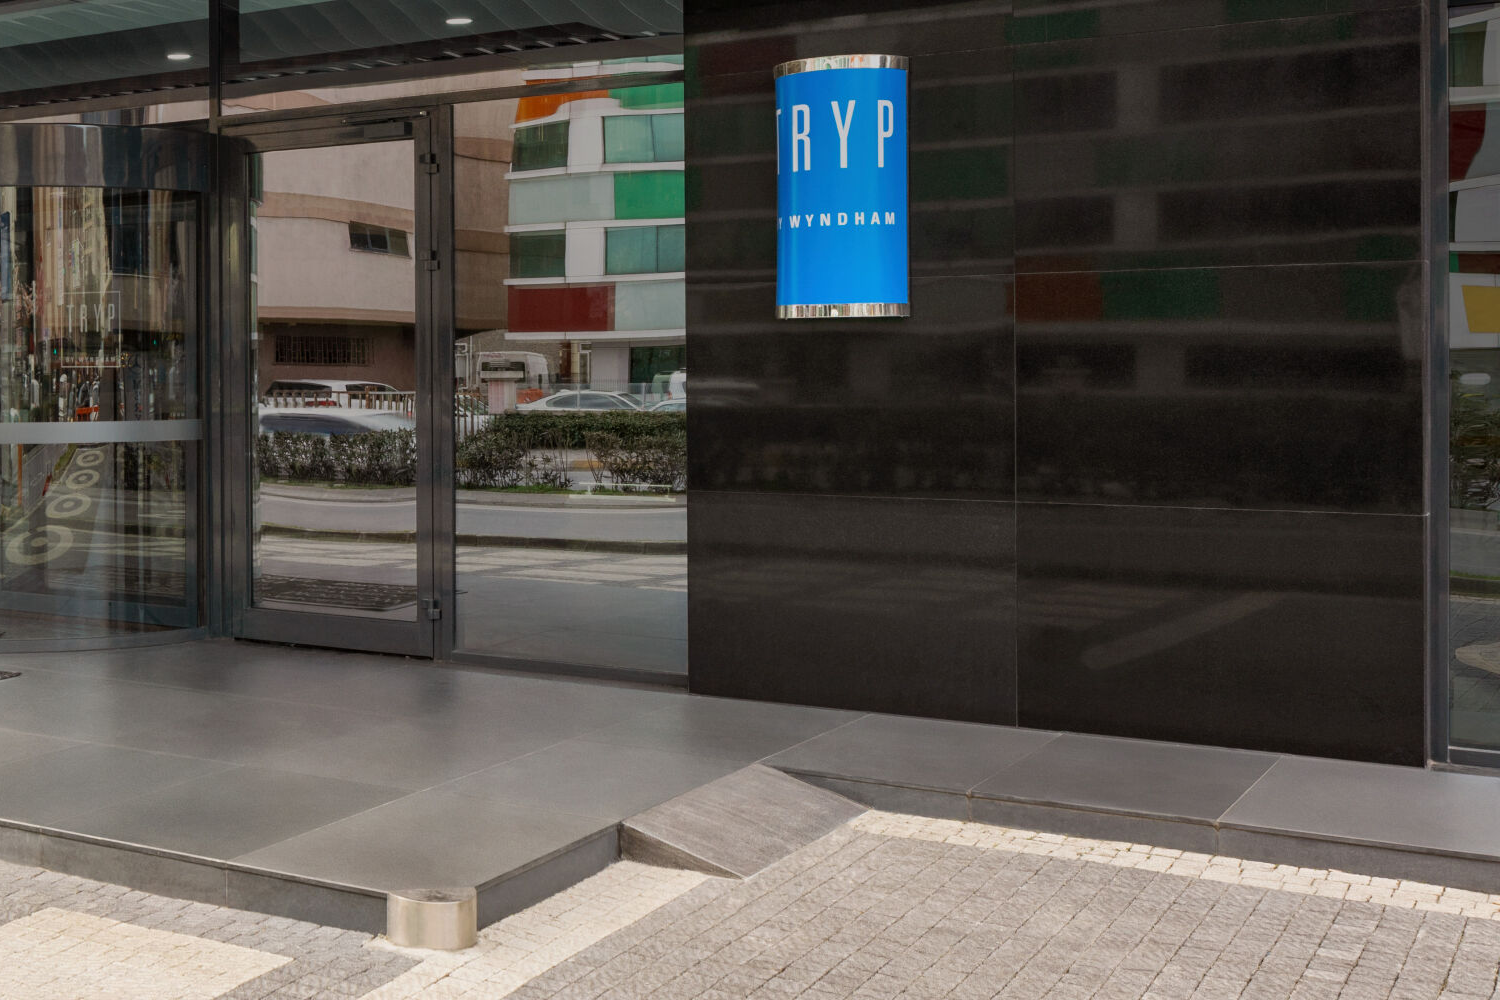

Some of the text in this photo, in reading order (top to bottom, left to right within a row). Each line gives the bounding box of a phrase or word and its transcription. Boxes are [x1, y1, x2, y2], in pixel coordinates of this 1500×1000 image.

[789, 211, 896, 229] WYNDHAM
[66, 303, 115, 333] TRYP
[78, 355, 116, 363] WYNAM
